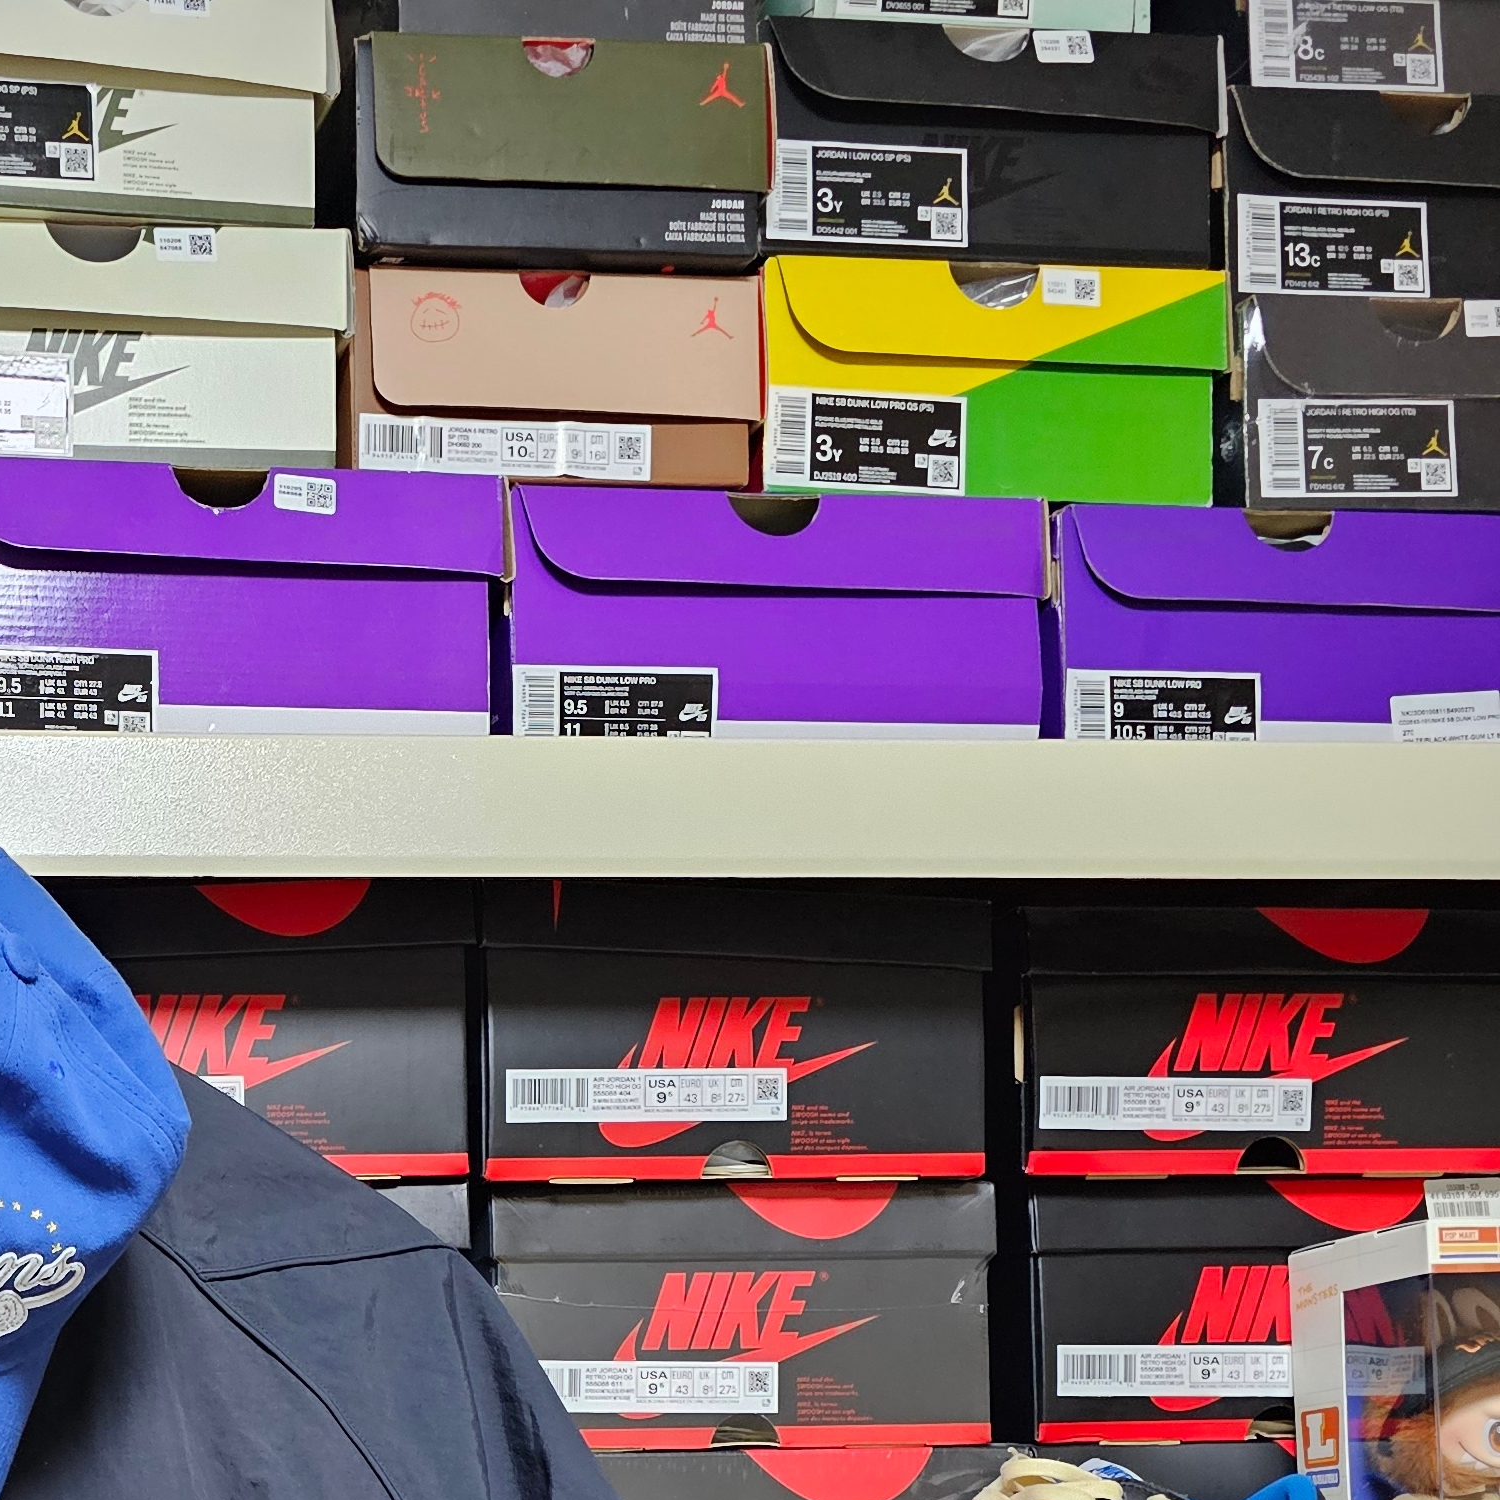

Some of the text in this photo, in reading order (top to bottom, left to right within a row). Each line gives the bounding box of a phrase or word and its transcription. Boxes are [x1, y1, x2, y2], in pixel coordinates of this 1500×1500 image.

[711, 199, 744, 209] JORDAN
[505, 432, 535, 442] USA
[620, 677, 638, 685] LOW
[639, 677, 656, 685] PRO
[564, 700, 587, 715] 9.5
[1114, 702, 1124, 717] 9
[638, 996, 811, 1068] NIKE
[1173, 993, 1345, 1071] NIKE
[648, 1080, 676, 1089] USA
[684, 1094, 698, 1103] 43
[1177, 1089, 1204, 1099] USA
[1211, 1104, 1225, 1113] 43
[1181, 1265, 1291, 1343] NIK
[642, 1270, 816, 1351] NIKE
[1193, 1356, 1219, 1365] USA
[640, 1371, 668, 1379] USA
[1227, 1370, 1240, 1379] 43
[675, 1386, 688, 1394] 43
